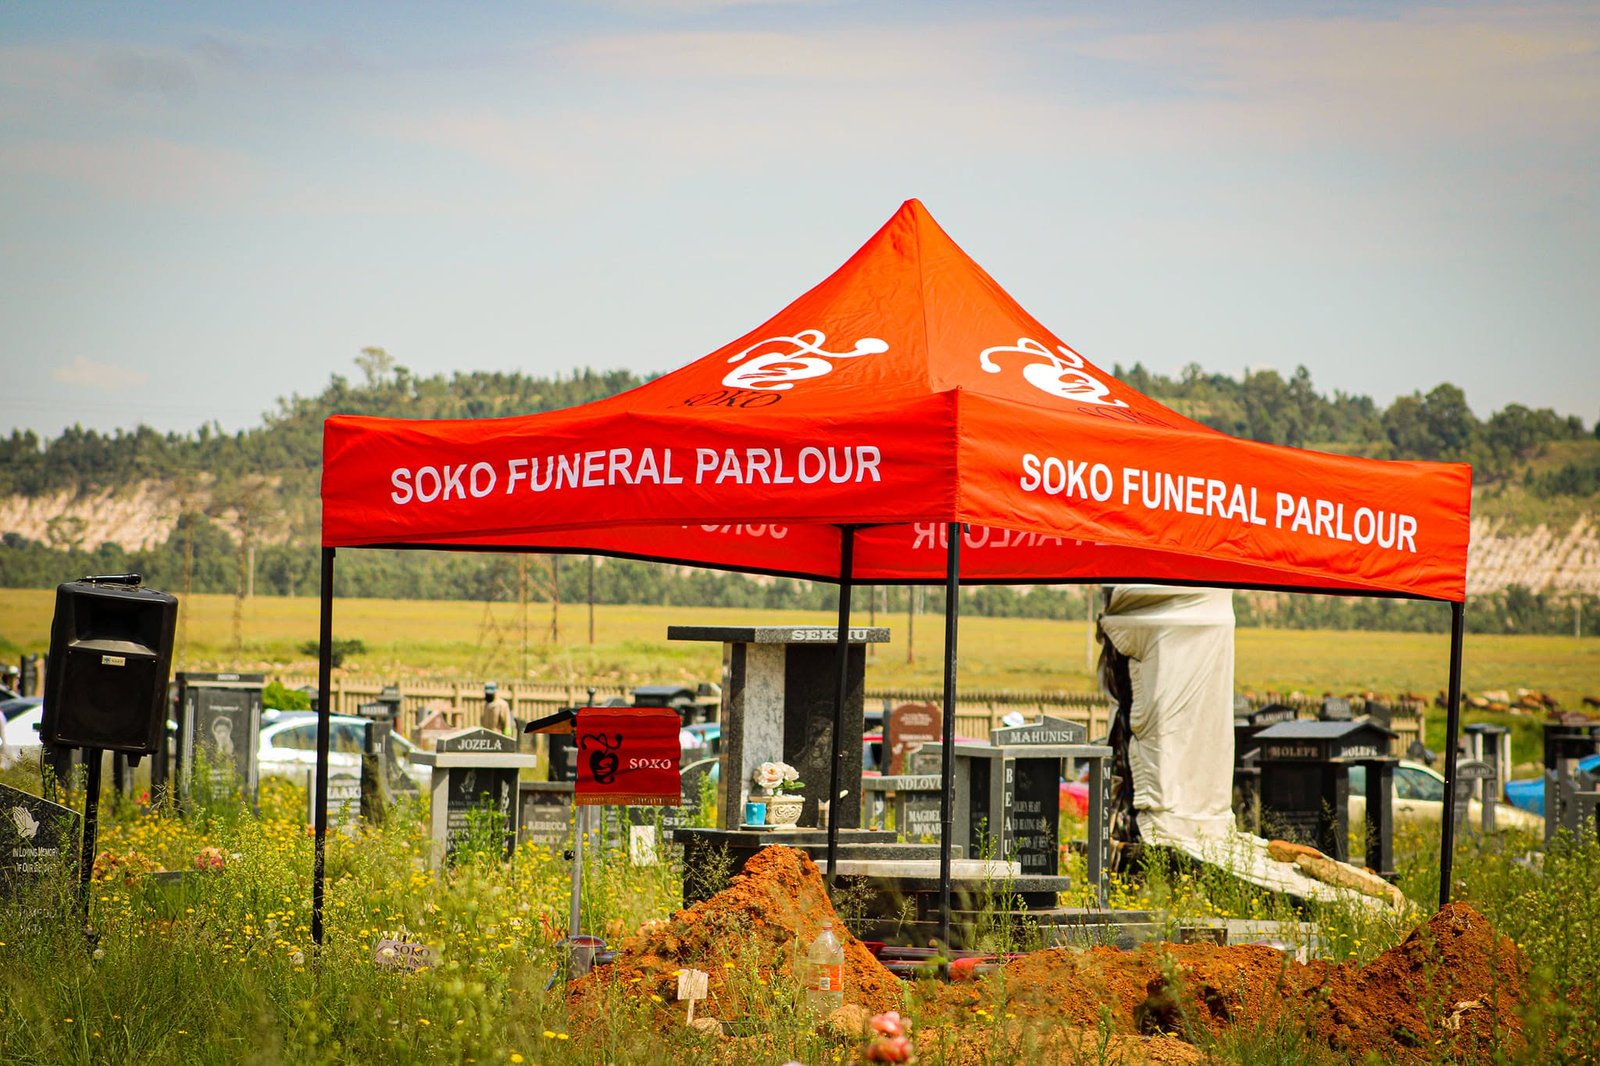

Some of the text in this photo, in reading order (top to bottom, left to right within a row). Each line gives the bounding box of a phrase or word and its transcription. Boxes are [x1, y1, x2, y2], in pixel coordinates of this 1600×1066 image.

[390, 445, 882, 505] SOKO FUNERAL PARLOUR
[1020, 453, 1418, 553] SOKO FUNERAL PARLOUR
[457, 739, 502, 751] JOZELA
[1010, 730, 1074, 744] MAHUNISI
[629, 757, 673, 770] SOKO
[1003, 767, 1014, 856] BEAU
